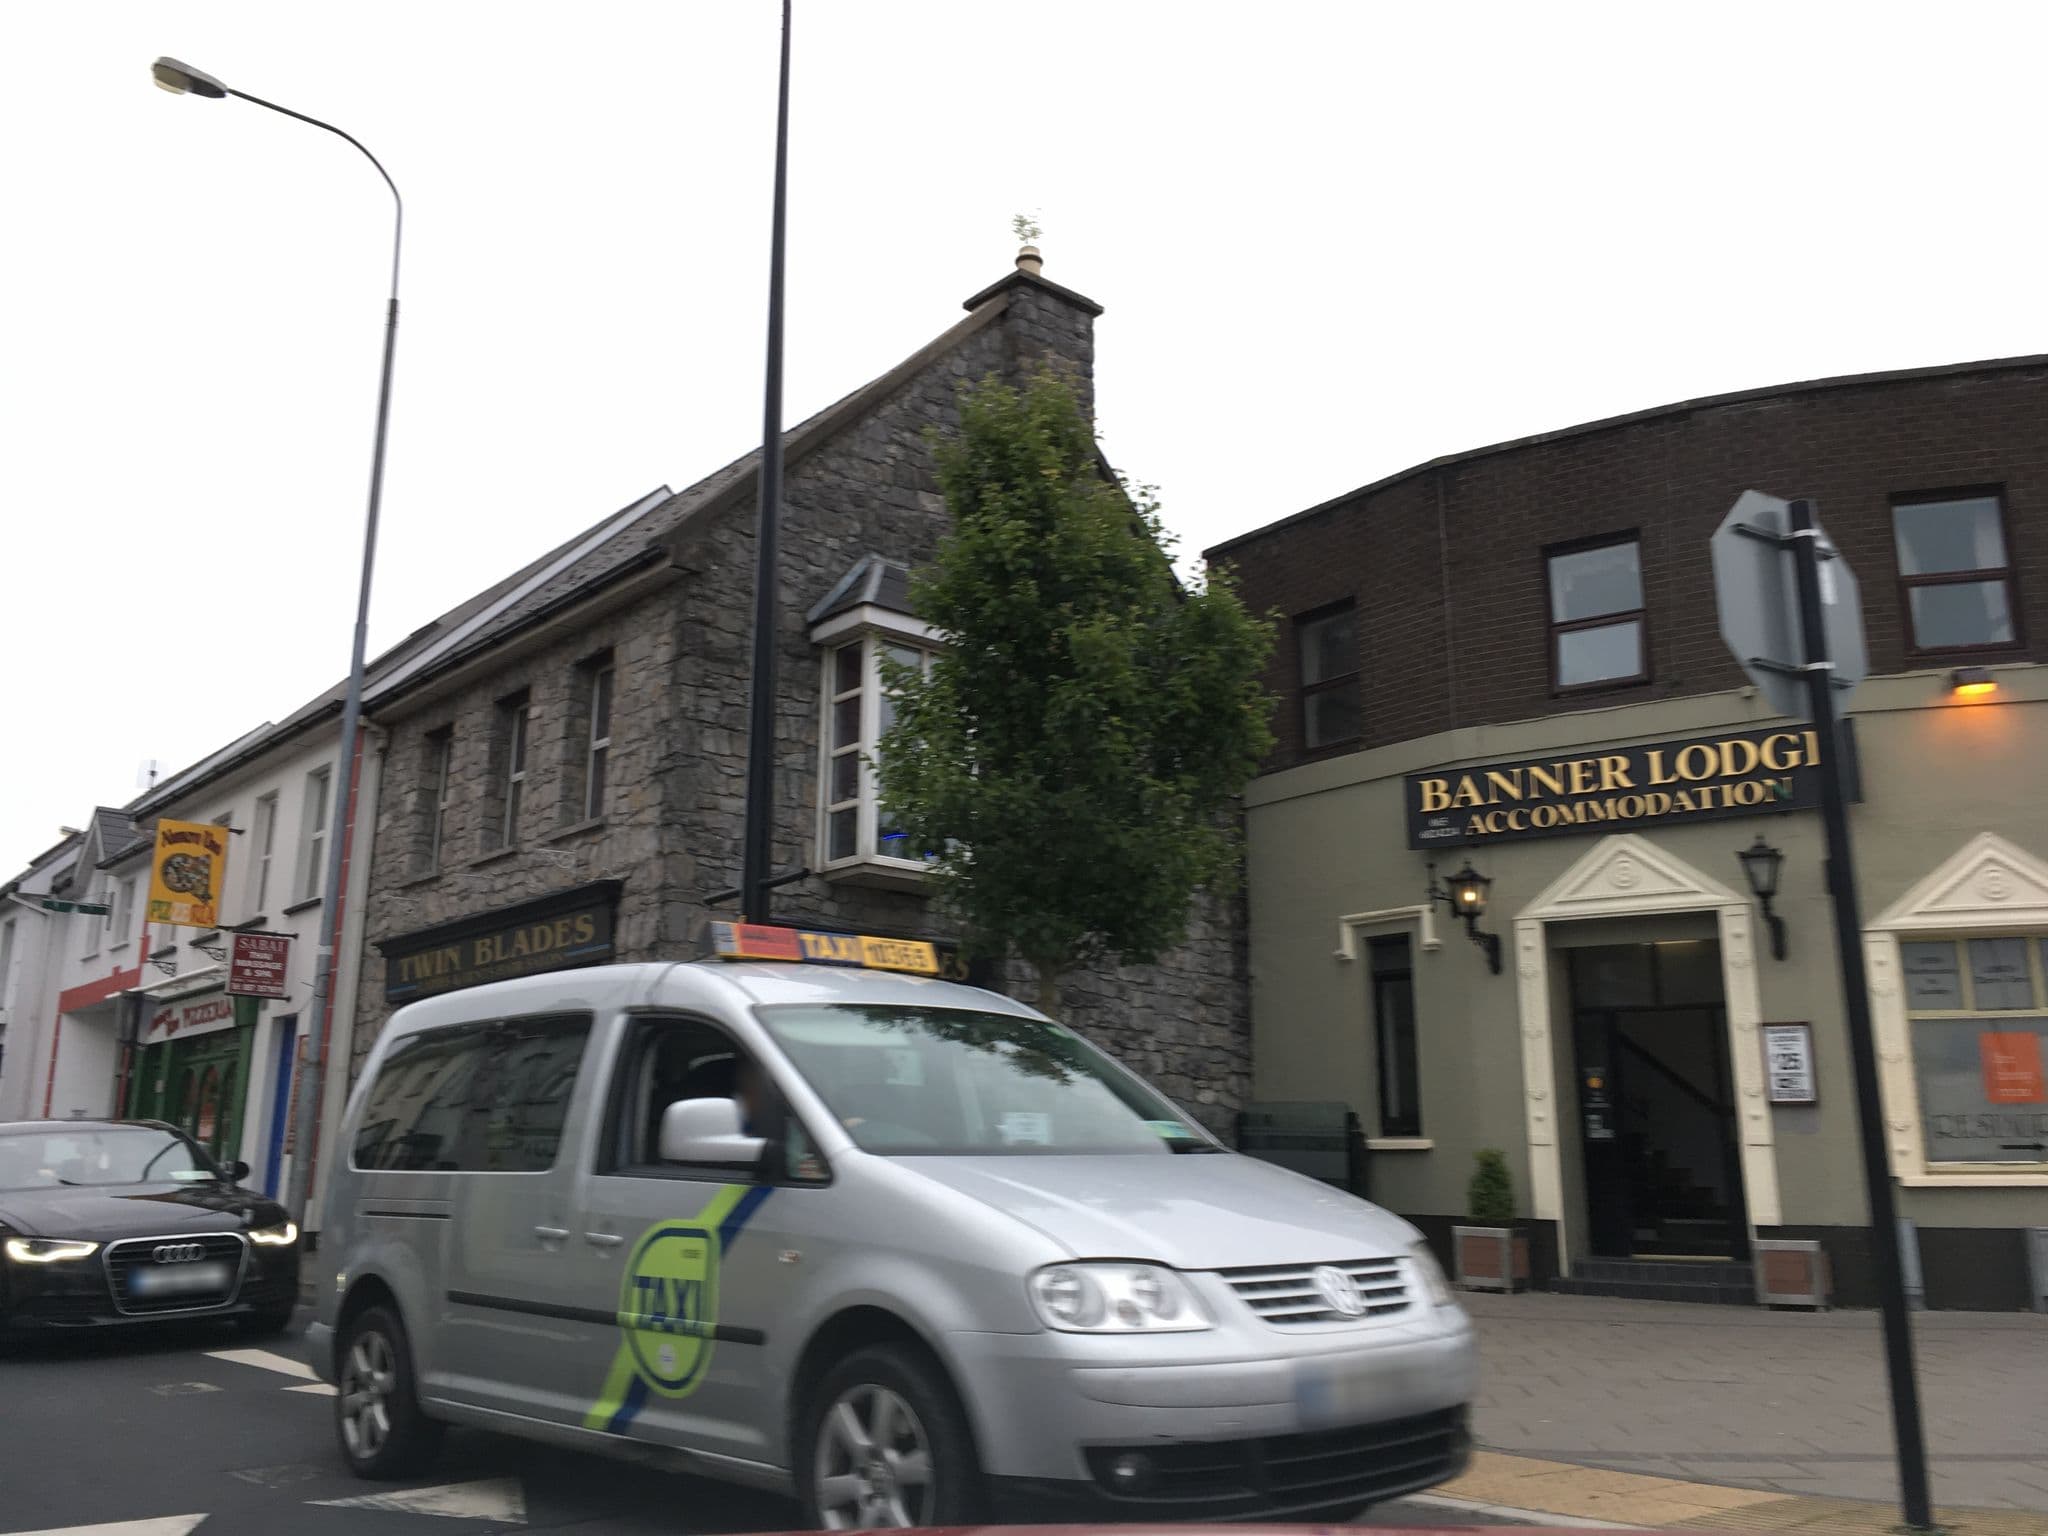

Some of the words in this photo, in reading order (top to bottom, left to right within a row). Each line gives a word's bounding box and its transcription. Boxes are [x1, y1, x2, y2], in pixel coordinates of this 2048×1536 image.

[1417, 755, 1637, 812] BANNER
[1464, 776, 1793, 835] ACCOMMODATION
[234, 959, 283, 970] MASSAGE
[400, 946, 461, 982] TWIN
[473, 913, 595, 965] BLADES
[800, 933, 861, 962] TAXI
[632, 1275, 710, 1337] TAXI
